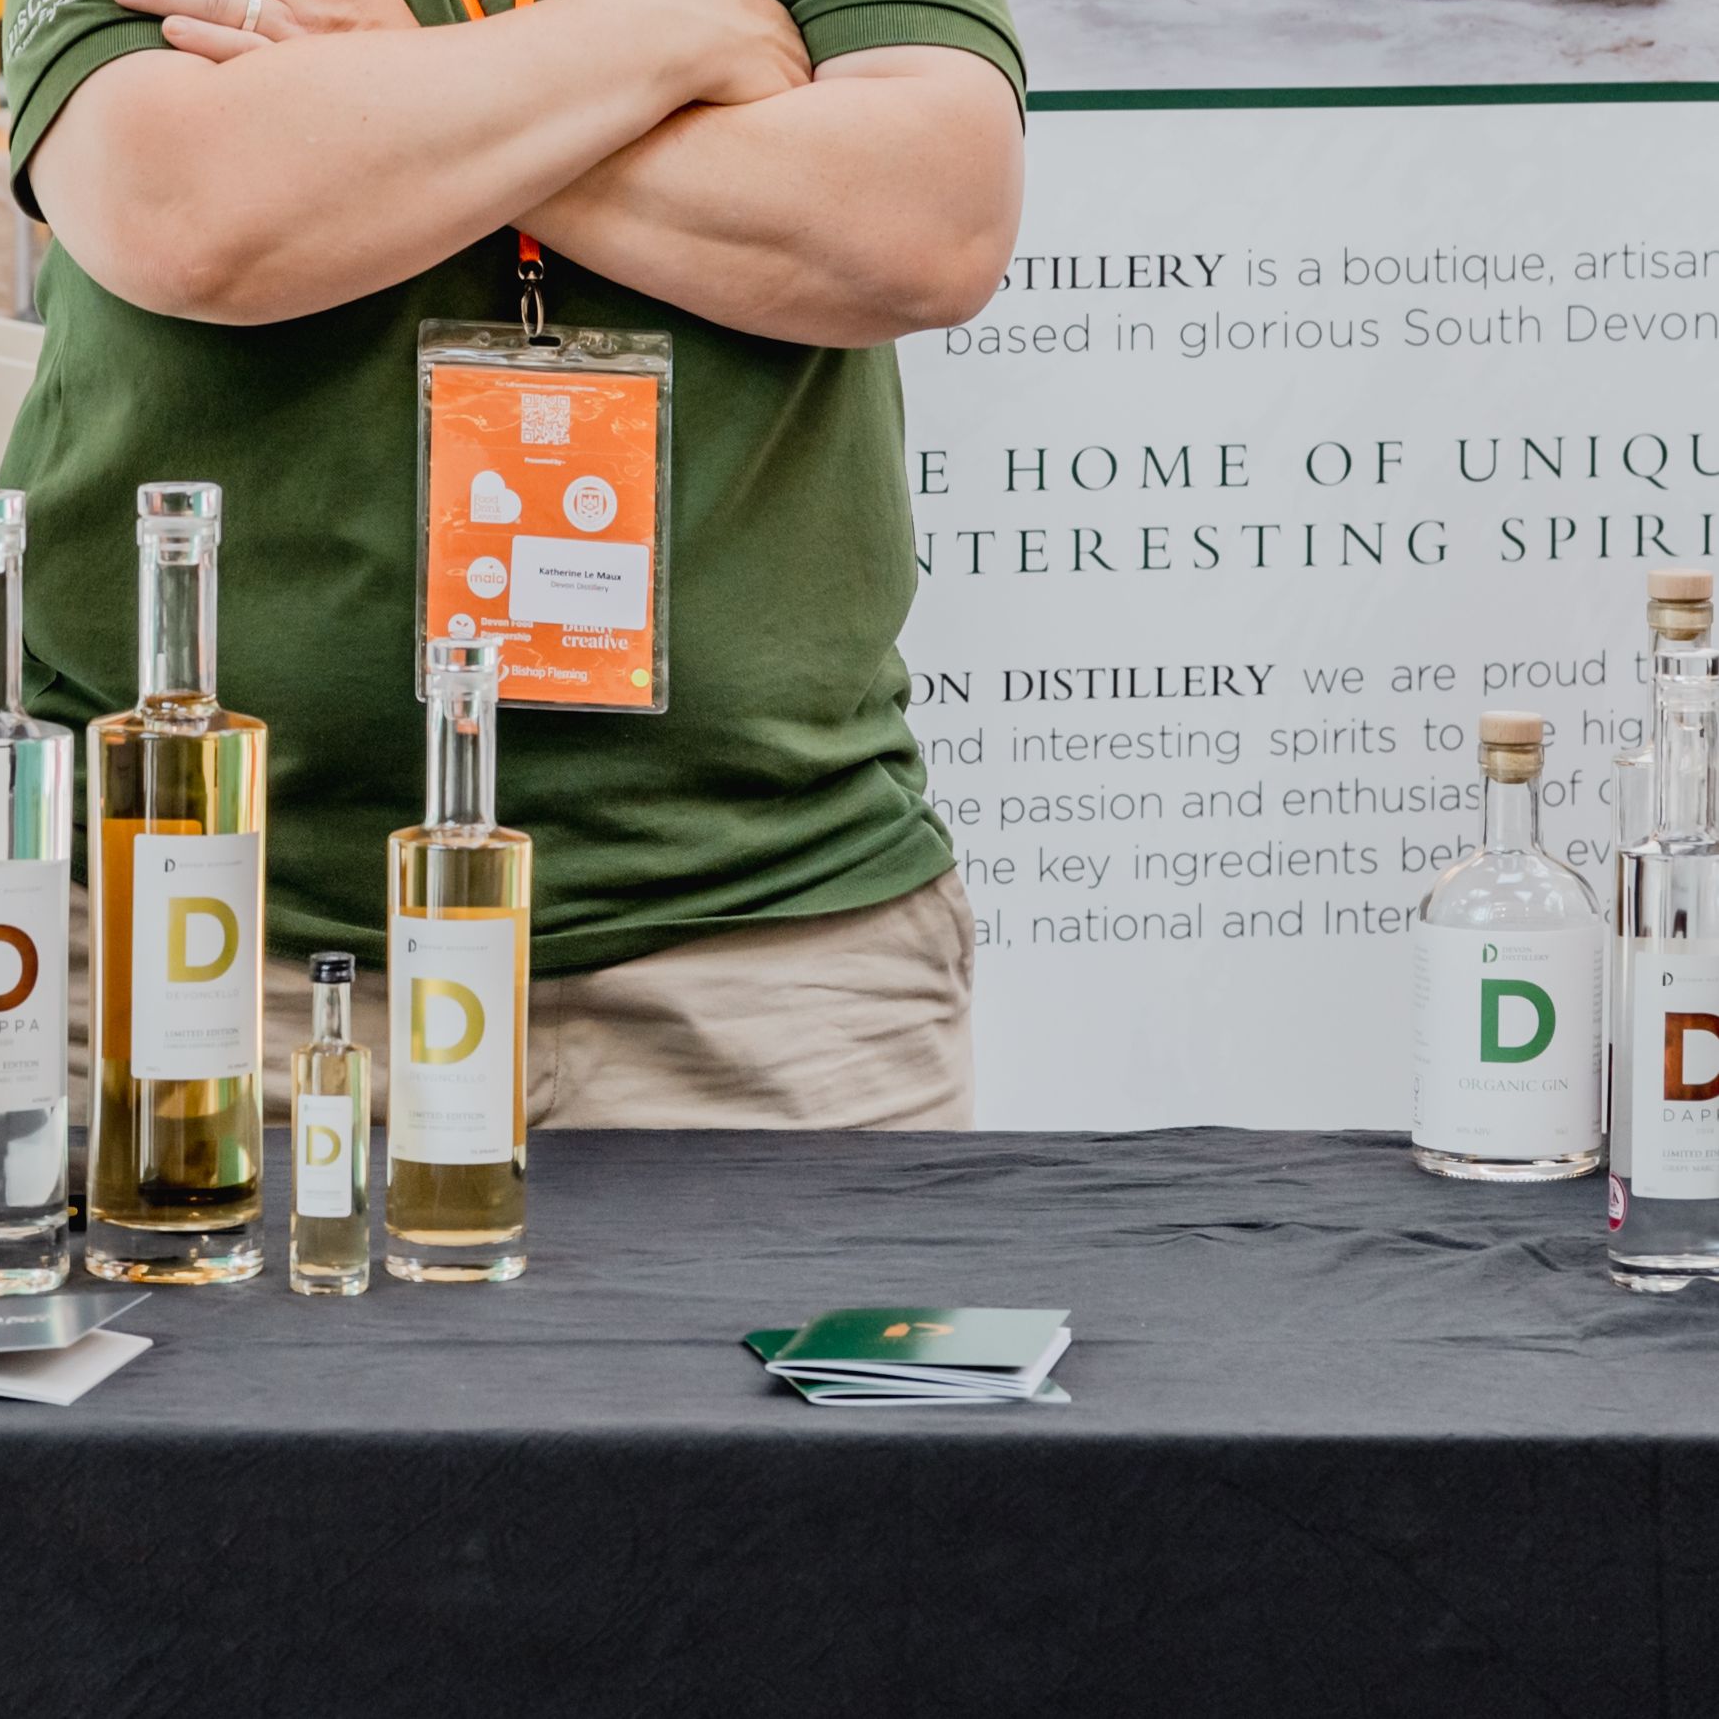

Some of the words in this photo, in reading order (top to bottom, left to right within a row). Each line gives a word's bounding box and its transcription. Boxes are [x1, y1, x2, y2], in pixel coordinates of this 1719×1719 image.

[996, 254, 1226, 293] TILLERY
[1246, 248, 1278, 288] is
[1297, 257, 1321, 287] a
[1342, 245, 1555, 290] boutique,
[944, 312, 1090, 356] based
[1117, 313, 1155, 352] in
[1179, 310, 1381, 359] glorious
[1404, 305, 1542, 346] South
[1567, 304, 1719, 343] Devon
[1003, 443, 1250, 493] HOME
[1305, 440, 1403, 487] OF
[539, 567, 582, 579] Katherine
[584, 570, 595, 580] Le
[596, 570, 622, 581] Maux
[561, 634, 629, 650] creative
[512, 665, 546, 679] Bishop
[547, 666, 588, 682] Fleming
[1002, 663, 1275, 703] DISTILLERY
[1302, 666, 1365, 694] we
[1390, 663, 1456, 693] are
[1483, 649, 1606, 697] proud
[1012, 722, 1241, 765] interesting
[1269, 718, 1397, 761] spirits
[1423, 717, 1465, 752] to
[1000, 785, 1163, 831] passion
[1181, 780, 1263, 819] and
[1282, 775, 1479, 817] enthusias
[1542, 769, 1584, 808] of
[957, 849, 1016, 885] he
[1039, 846, 1111, 890] key
[1134, 839, 1379, 887] ingredients
[167, 896, 239, 983] D
[1032, 902, 1202, 944] national
[1222, 899, 1303, 939] and
[1325, 900, 1419, 935] Inter
[410, 977, 485, 1065] D
[1481, 978, 1556, 1063] D
[1664, 1012, 1719, 1101] D
[1458, 1077, 1538, 1092] ORGANIC
[1541, 1077, 1569, 1091] GIN
[1663, 1108, 1719, 1123] DAP
[306, 1125, 341, 1166] D
